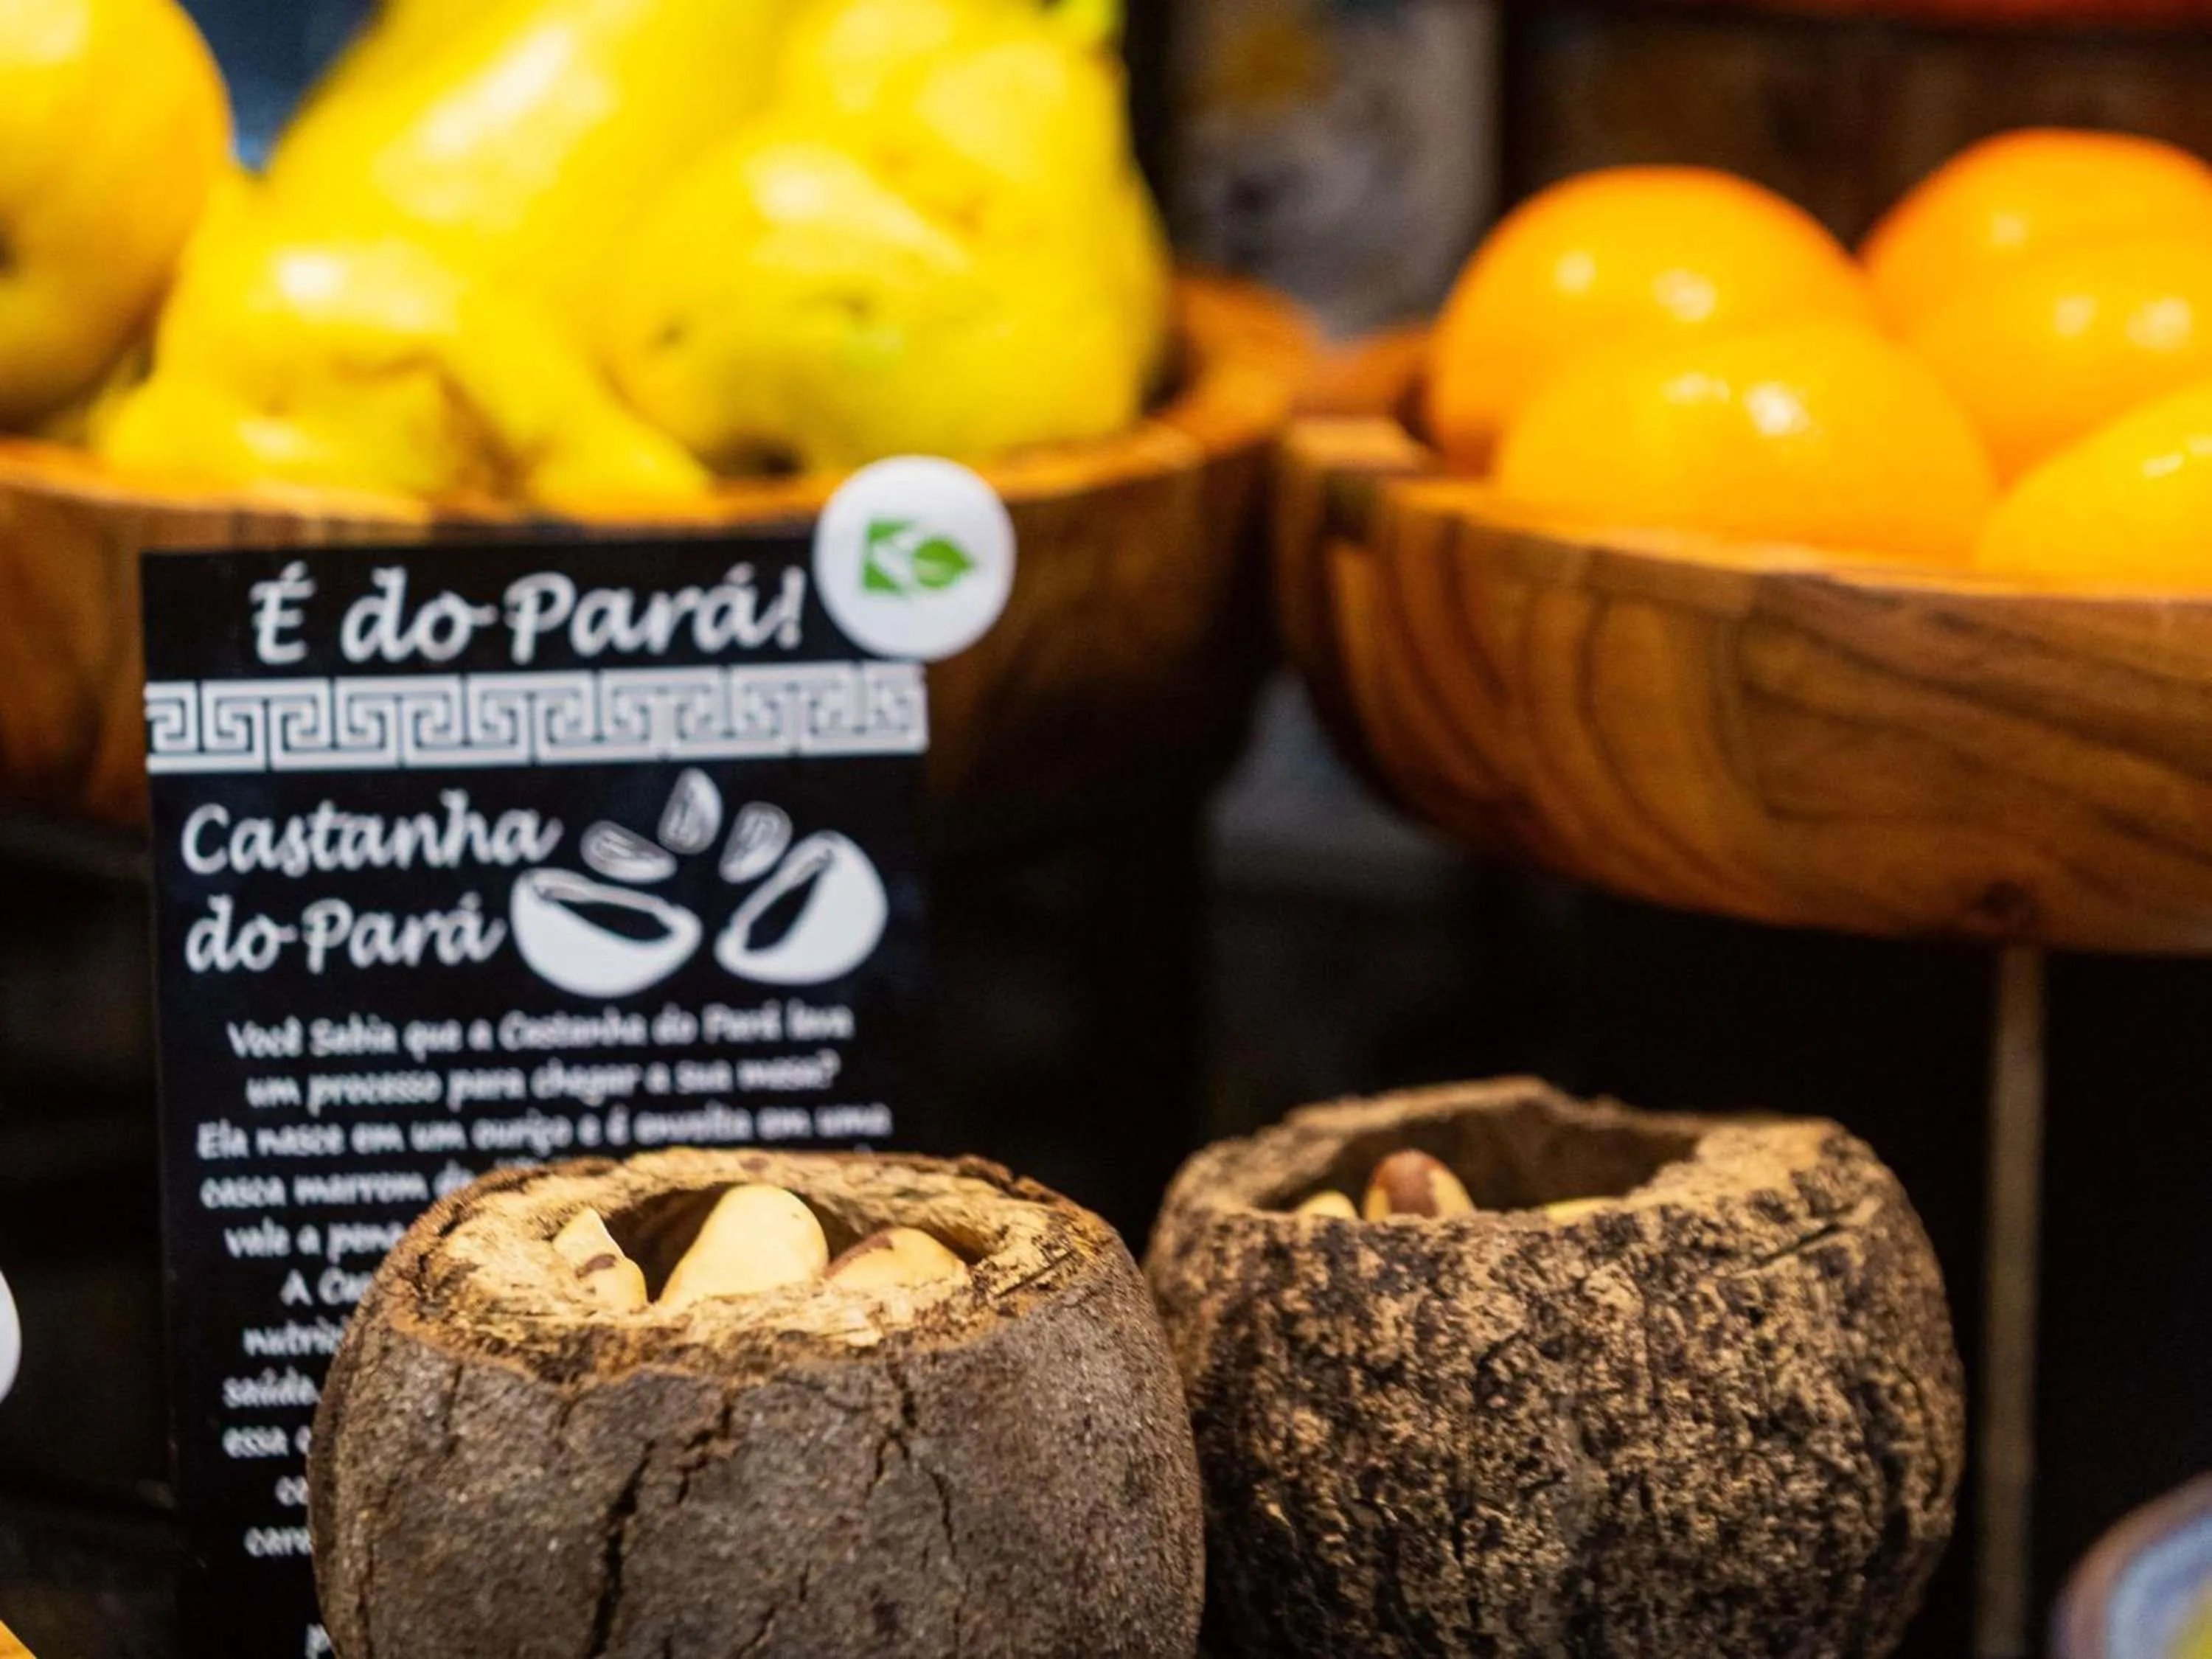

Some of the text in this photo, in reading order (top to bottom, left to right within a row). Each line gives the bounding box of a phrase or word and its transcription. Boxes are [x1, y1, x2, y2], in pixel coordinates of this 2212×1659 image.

[251, 562, 806, 665] É do Pará!
[181, 789, 563, 874] Castanha
[185, 893, 506, 973] do Pará
[227, 1015, 303, 1058] Você
[403, 1020, 462, 1062] que
[467, 1020, 493, 1050] a
[498, 1009, 647, 1051] Castanha
[651, 1004, 698, 1044] do
[703, 1003, 782, 1042] Pará
[246, 1077, 302, 1107] um
[307, 1071, 442, 1116] processo
[447, 1068, 526, 1111] para
[530, 1059, 641, 1106] chegar
[675, 1062, 733, 1094] sua
[737, 1048, 840, 1090] mesa?
[196, 1119, 249, 1160] Ela
[255, 1124, 344, 1157] nasce
[350, 1123, 405, 1154] em
[410, 1122, 467, 1151] um
[756, 1109, 811, 1140] em
[815, 1104, 891, 1138] uma
[200, 1176, 286, 1209] casca
[293, 1172, 429, 1205] marrom
[224, 1217, 291, 1258] vale
[296, 1225, 321, 1255] a
[279, 1269, 313, 1306] A
